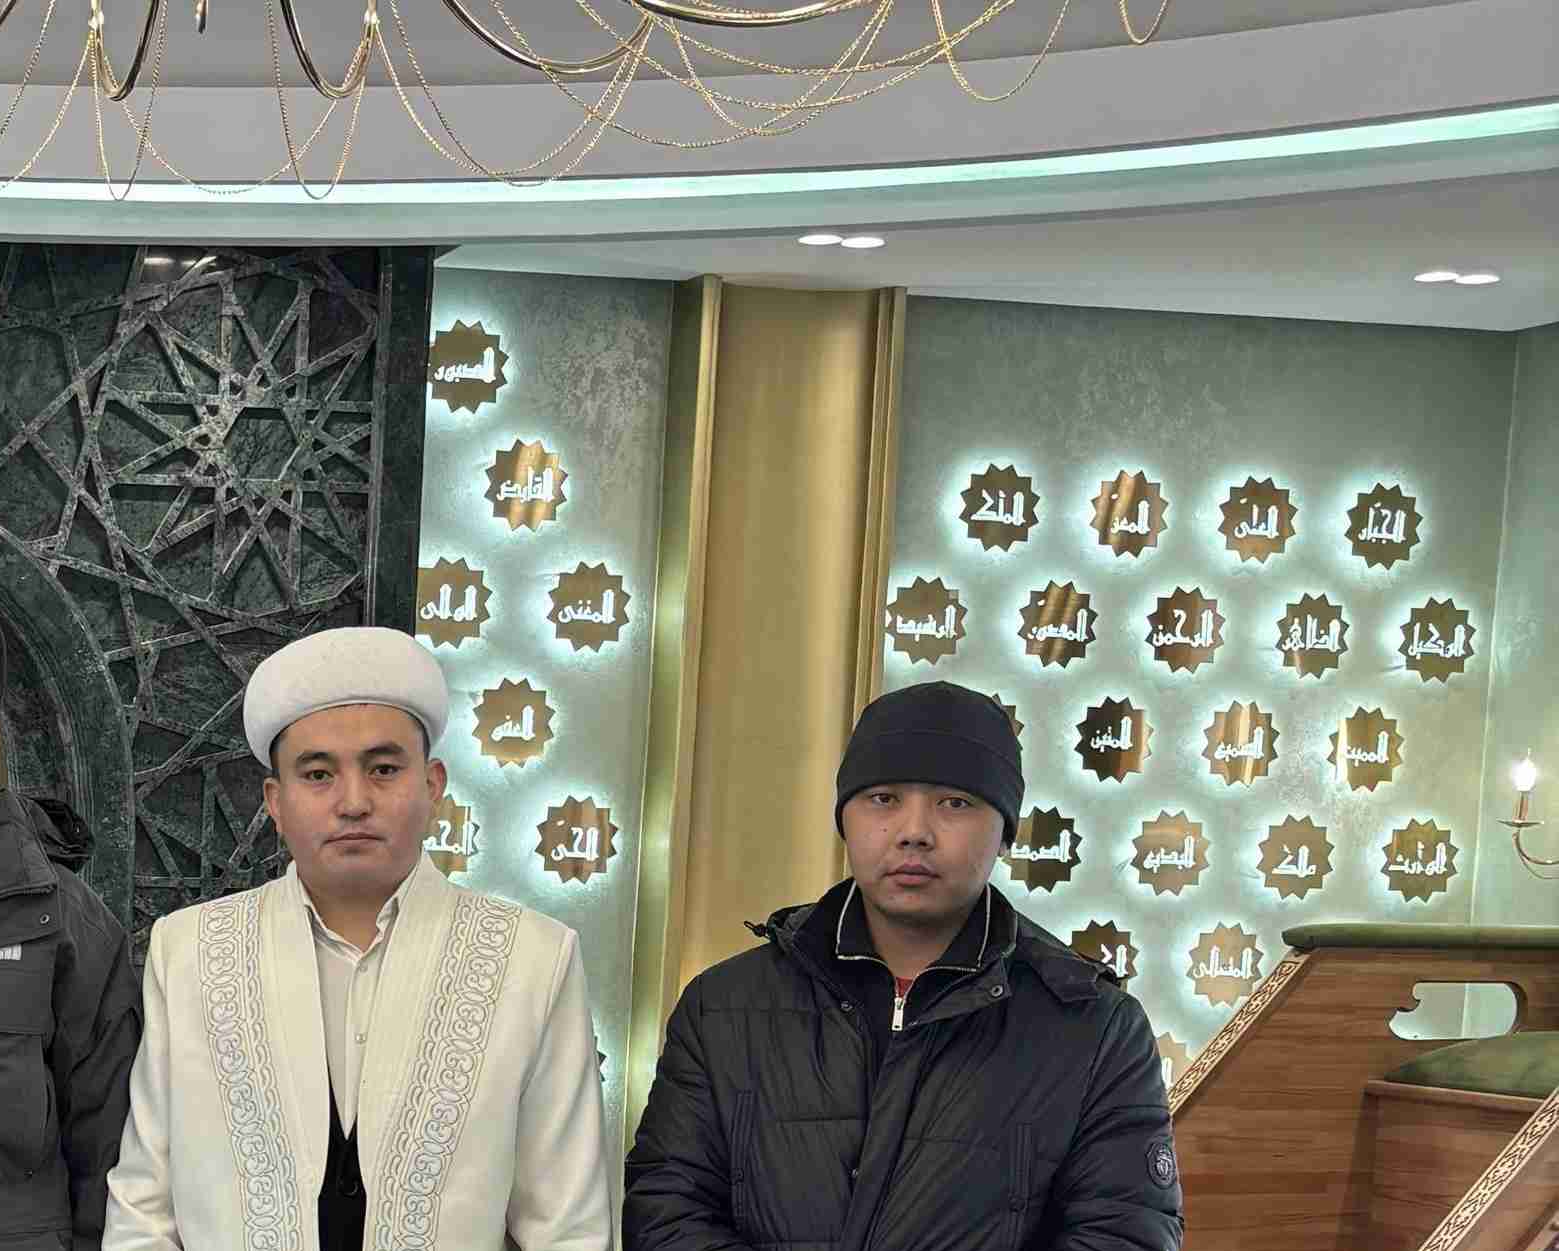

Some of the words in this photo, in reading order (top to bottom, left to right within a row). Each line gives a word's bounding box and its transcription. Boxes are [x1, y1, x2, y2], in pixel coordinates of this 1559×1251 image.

[434, 347, 496, 383] الصبور
[971, 489, 1026, 526] الملك
[1153, 609, 1214, 647] الرحمن
